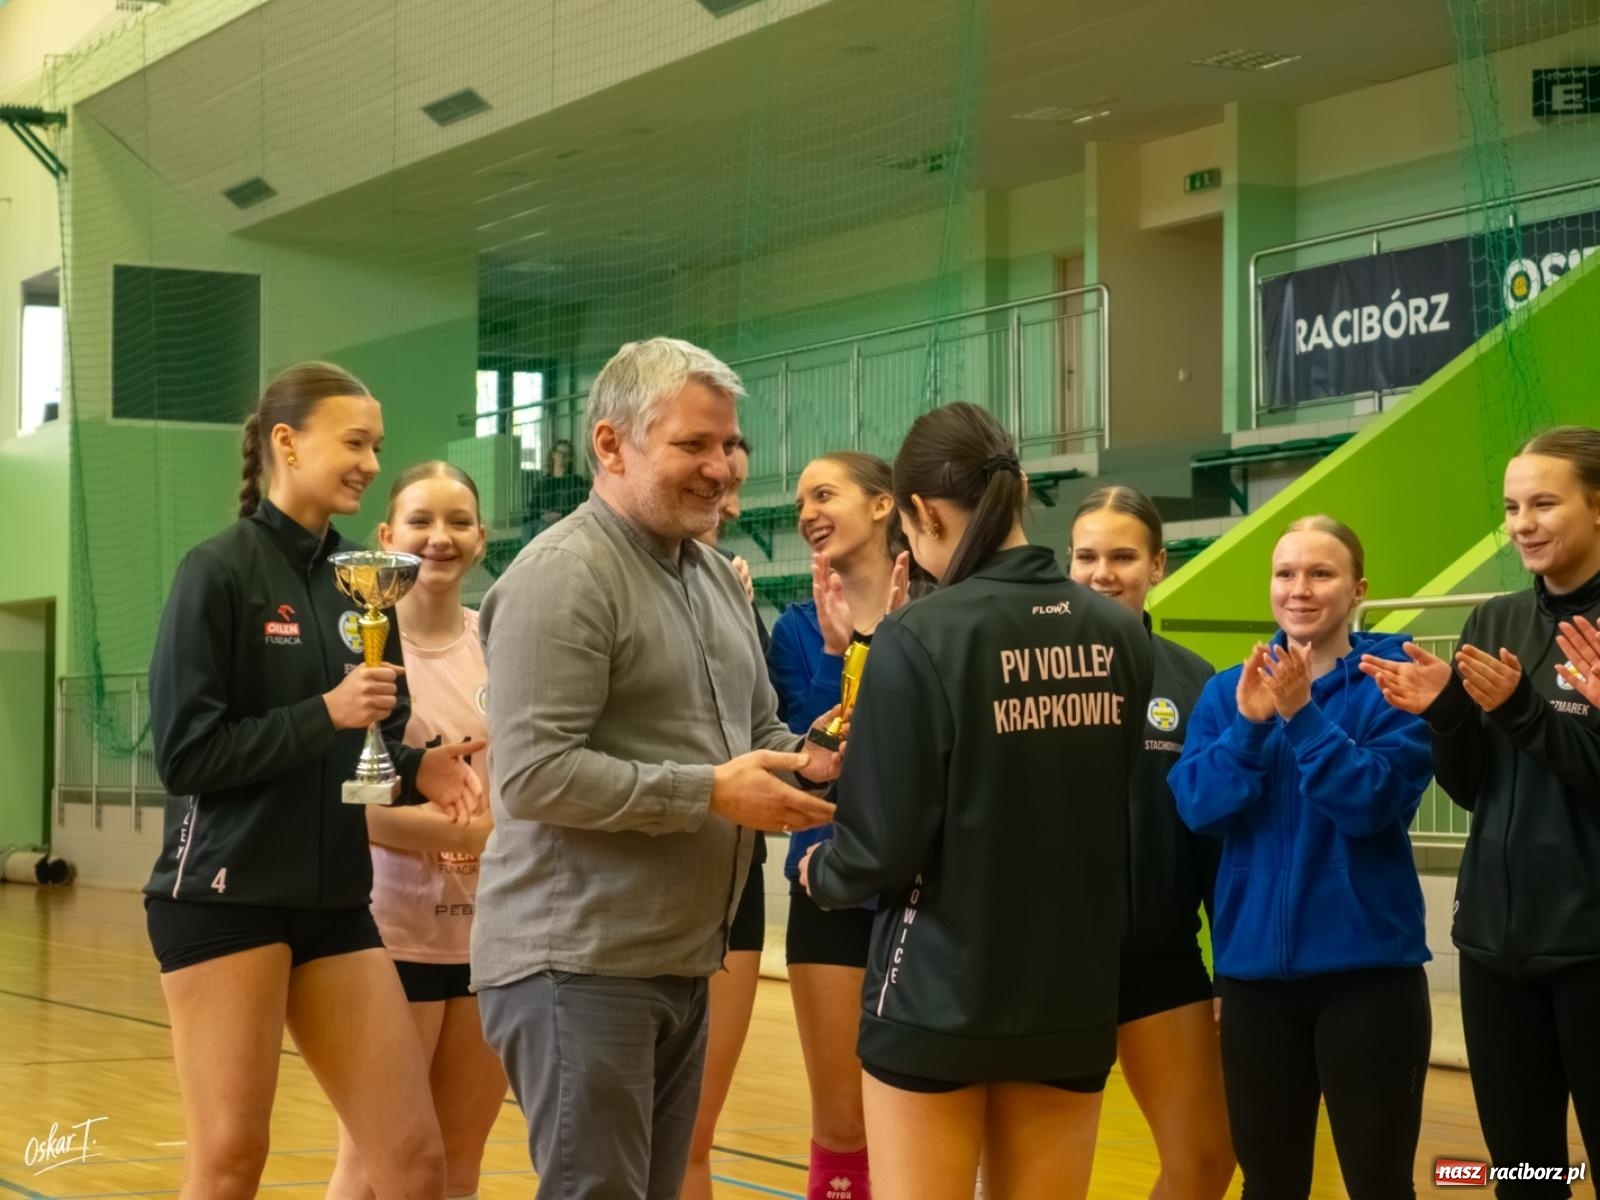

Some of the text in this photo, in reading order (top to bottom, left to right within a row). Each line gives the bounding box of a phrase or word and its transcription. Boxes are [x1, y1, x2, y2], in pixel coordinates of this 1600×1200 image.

[1551, 83, 1584, 111] E
[1296, 289, 1450, 355] RACIBÓRZ
[1001, 644, 1114, 684] PV VOLLEY
[211, 868, 227, 893] 4
